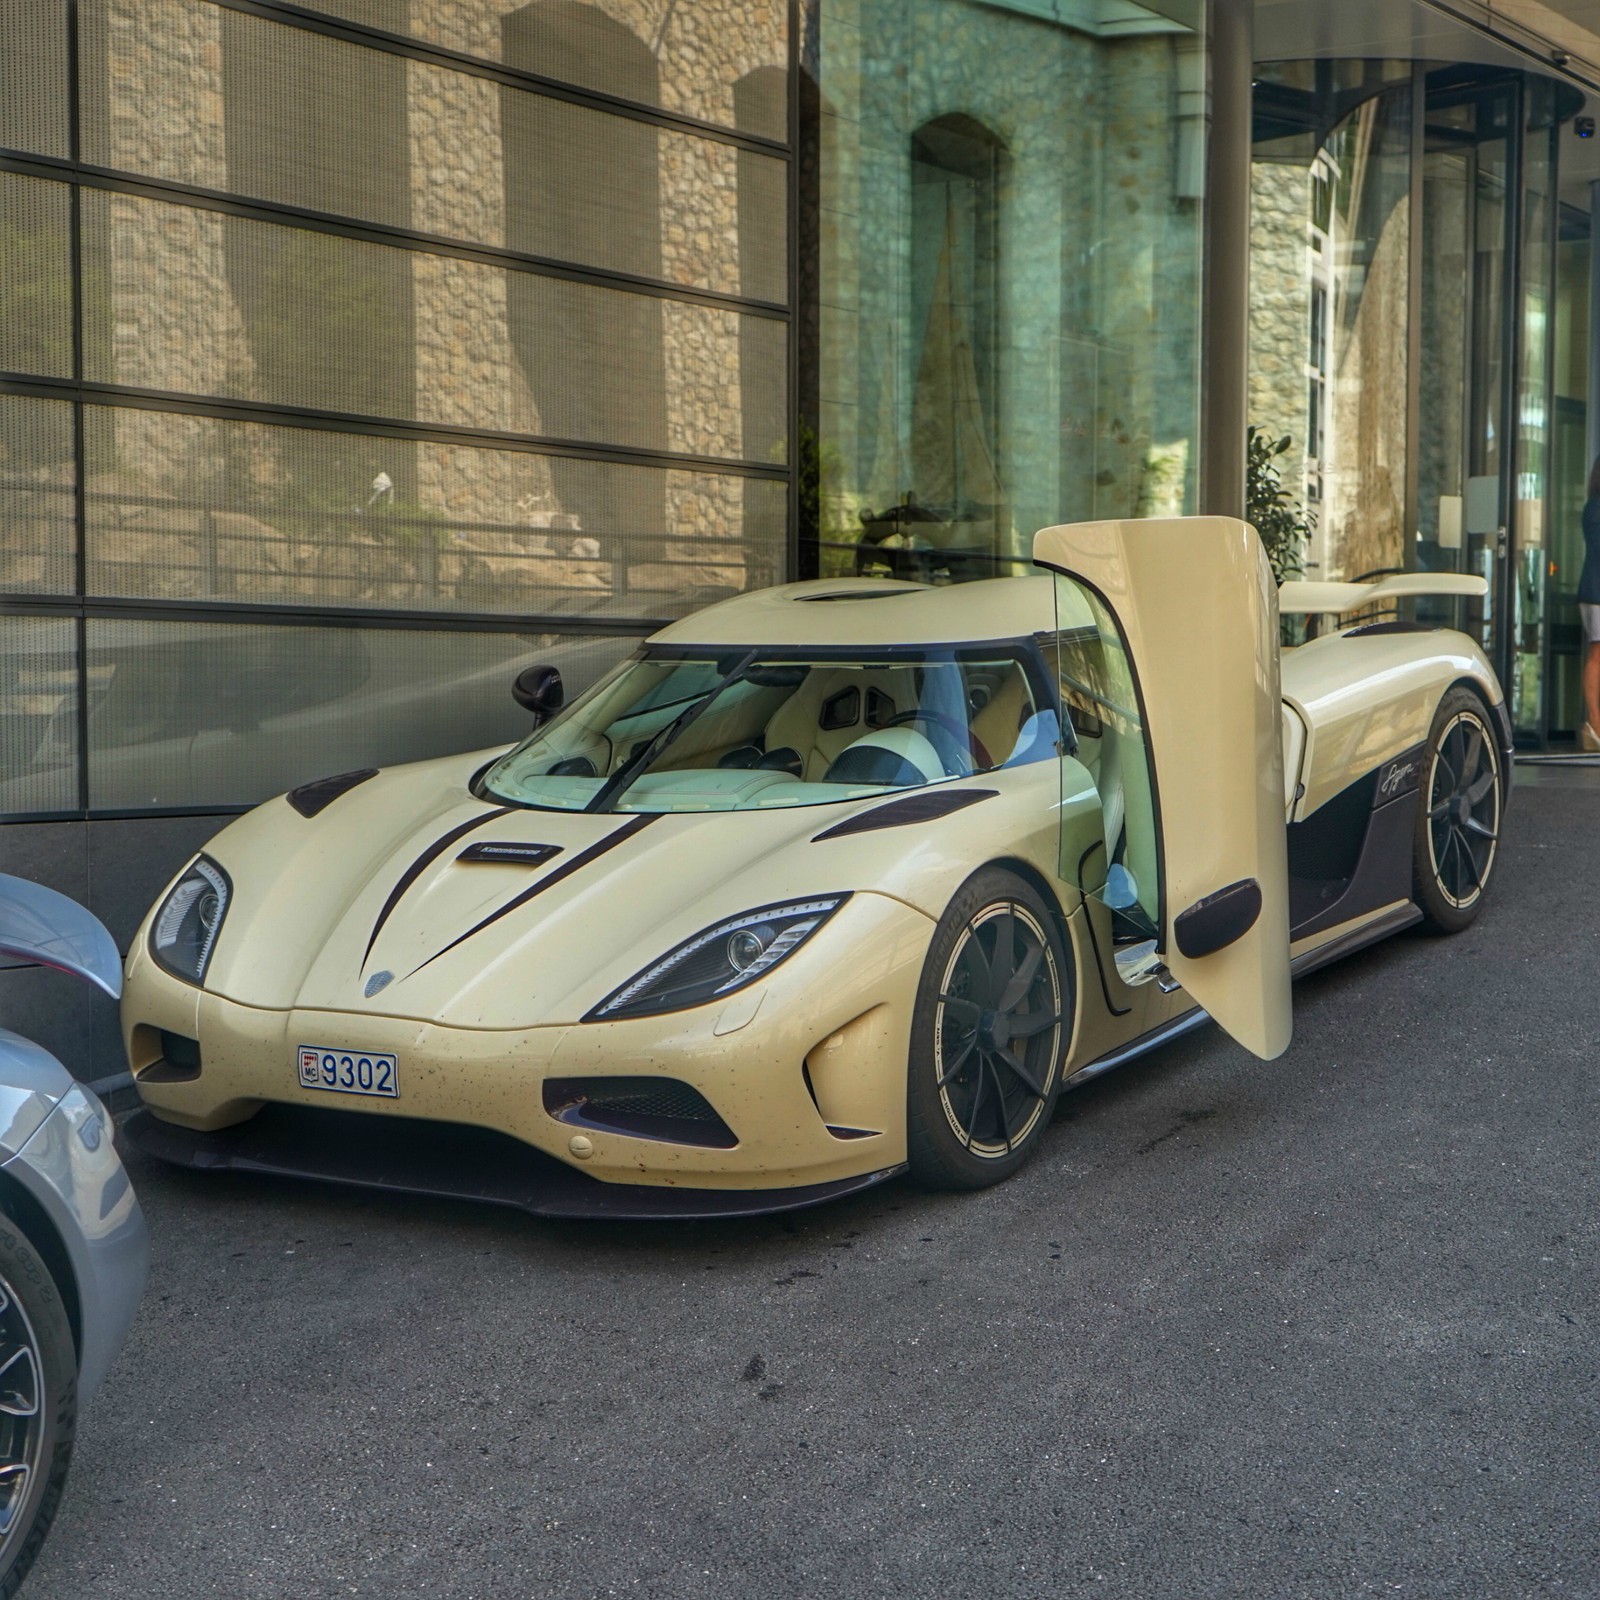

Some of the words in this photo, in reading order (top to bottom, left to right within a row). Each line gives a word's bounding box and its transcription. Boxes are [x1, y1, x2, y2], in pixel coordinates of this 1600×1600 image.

[304, 1067, 317, 1077] MC
[323, 1055, 393, 1091] 9302
[16, 1246, 42, 1284] Cup
[40, 1285, 54, 1304] 2
